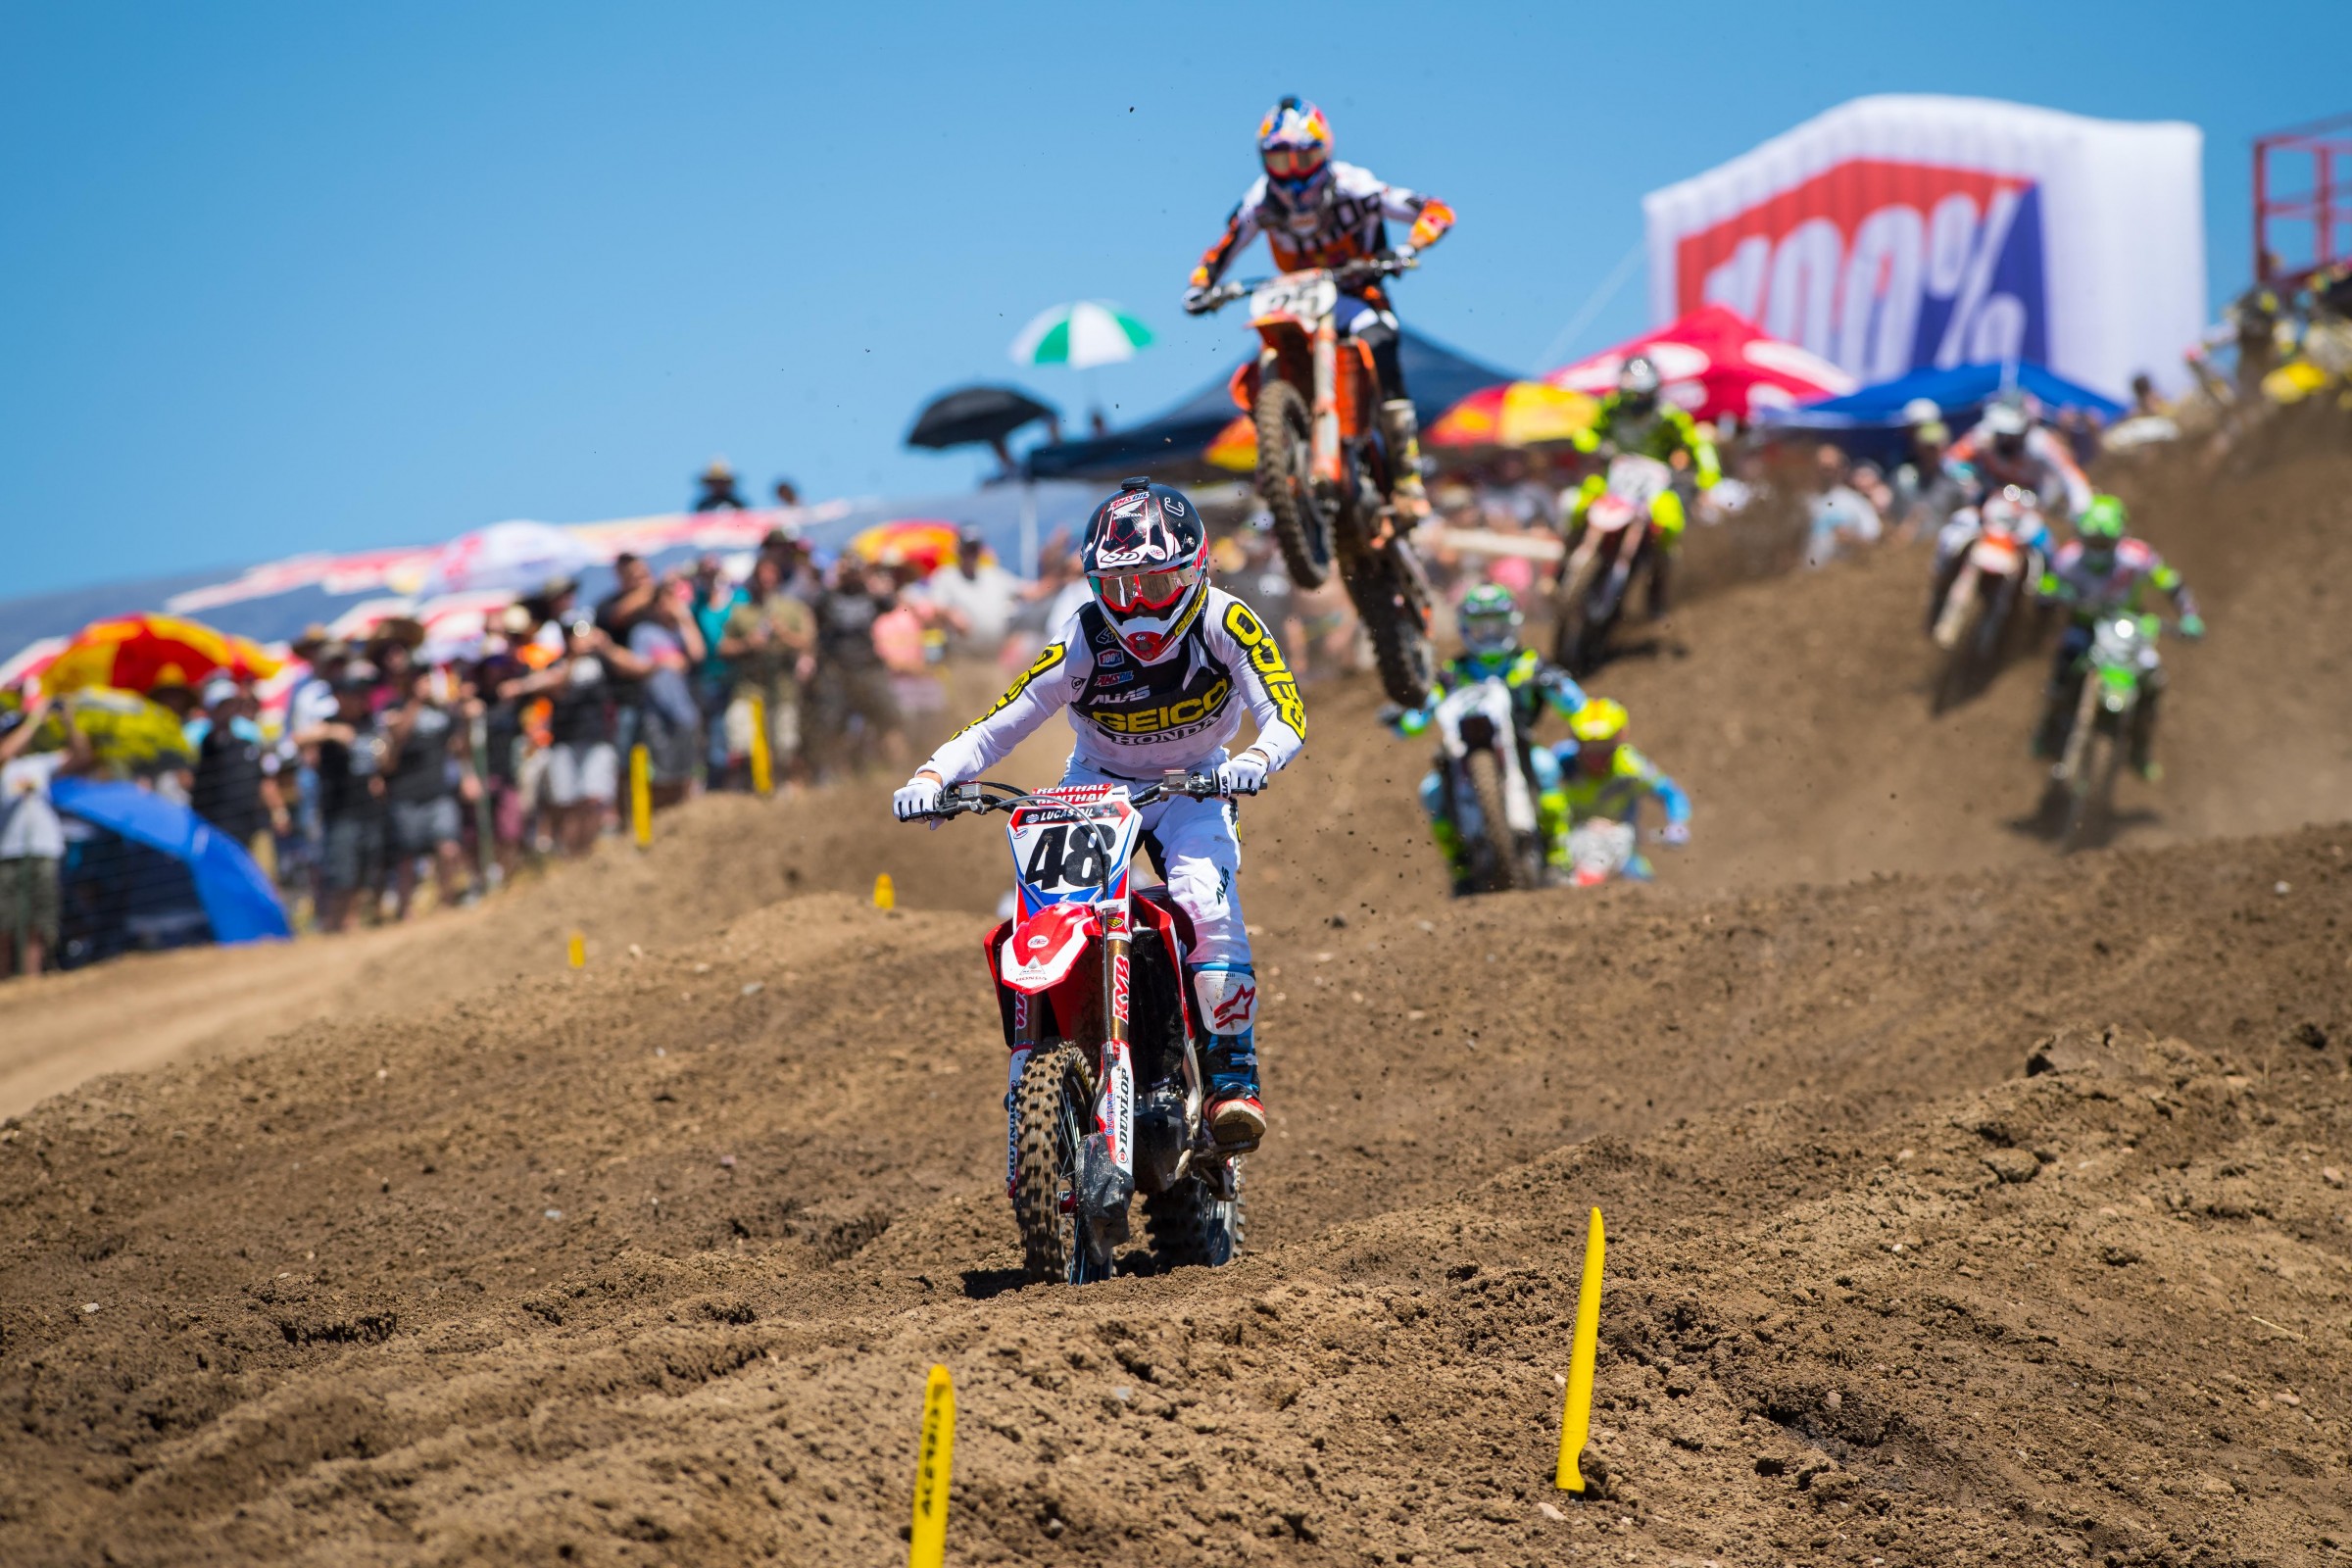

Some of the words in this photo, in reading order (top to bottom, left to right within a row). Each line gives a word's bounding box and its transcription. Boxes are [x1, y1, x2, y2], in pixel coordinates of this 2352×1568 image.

[1703, 189, 2025, 385] 100%
[1109, 492, 1149, 509] AMSOIL
[1101, 544, 1140, 564] 6D
[1101, 653, 1122, 663] 100%
[1223, 602, 1306, 744] GEICO
[1096, 671, 1134, 686] AMSOIL
[1092, 678, 1228, 732] GEICO
[1112, 716, 1221, 745] HONDA
[1036, 784, 1107, 794] RENTHAL
[1040, 809, 1074, 821] LUCAS
[1077, 808, 1094, 816] OIL
[1025, 824, 1116, 891] 48
[1112, 955, 1130, 1024] KYB
[1015, 991, 1027, 1029] YB
[1120, 1067, 1130, 1148] DUNLOP
